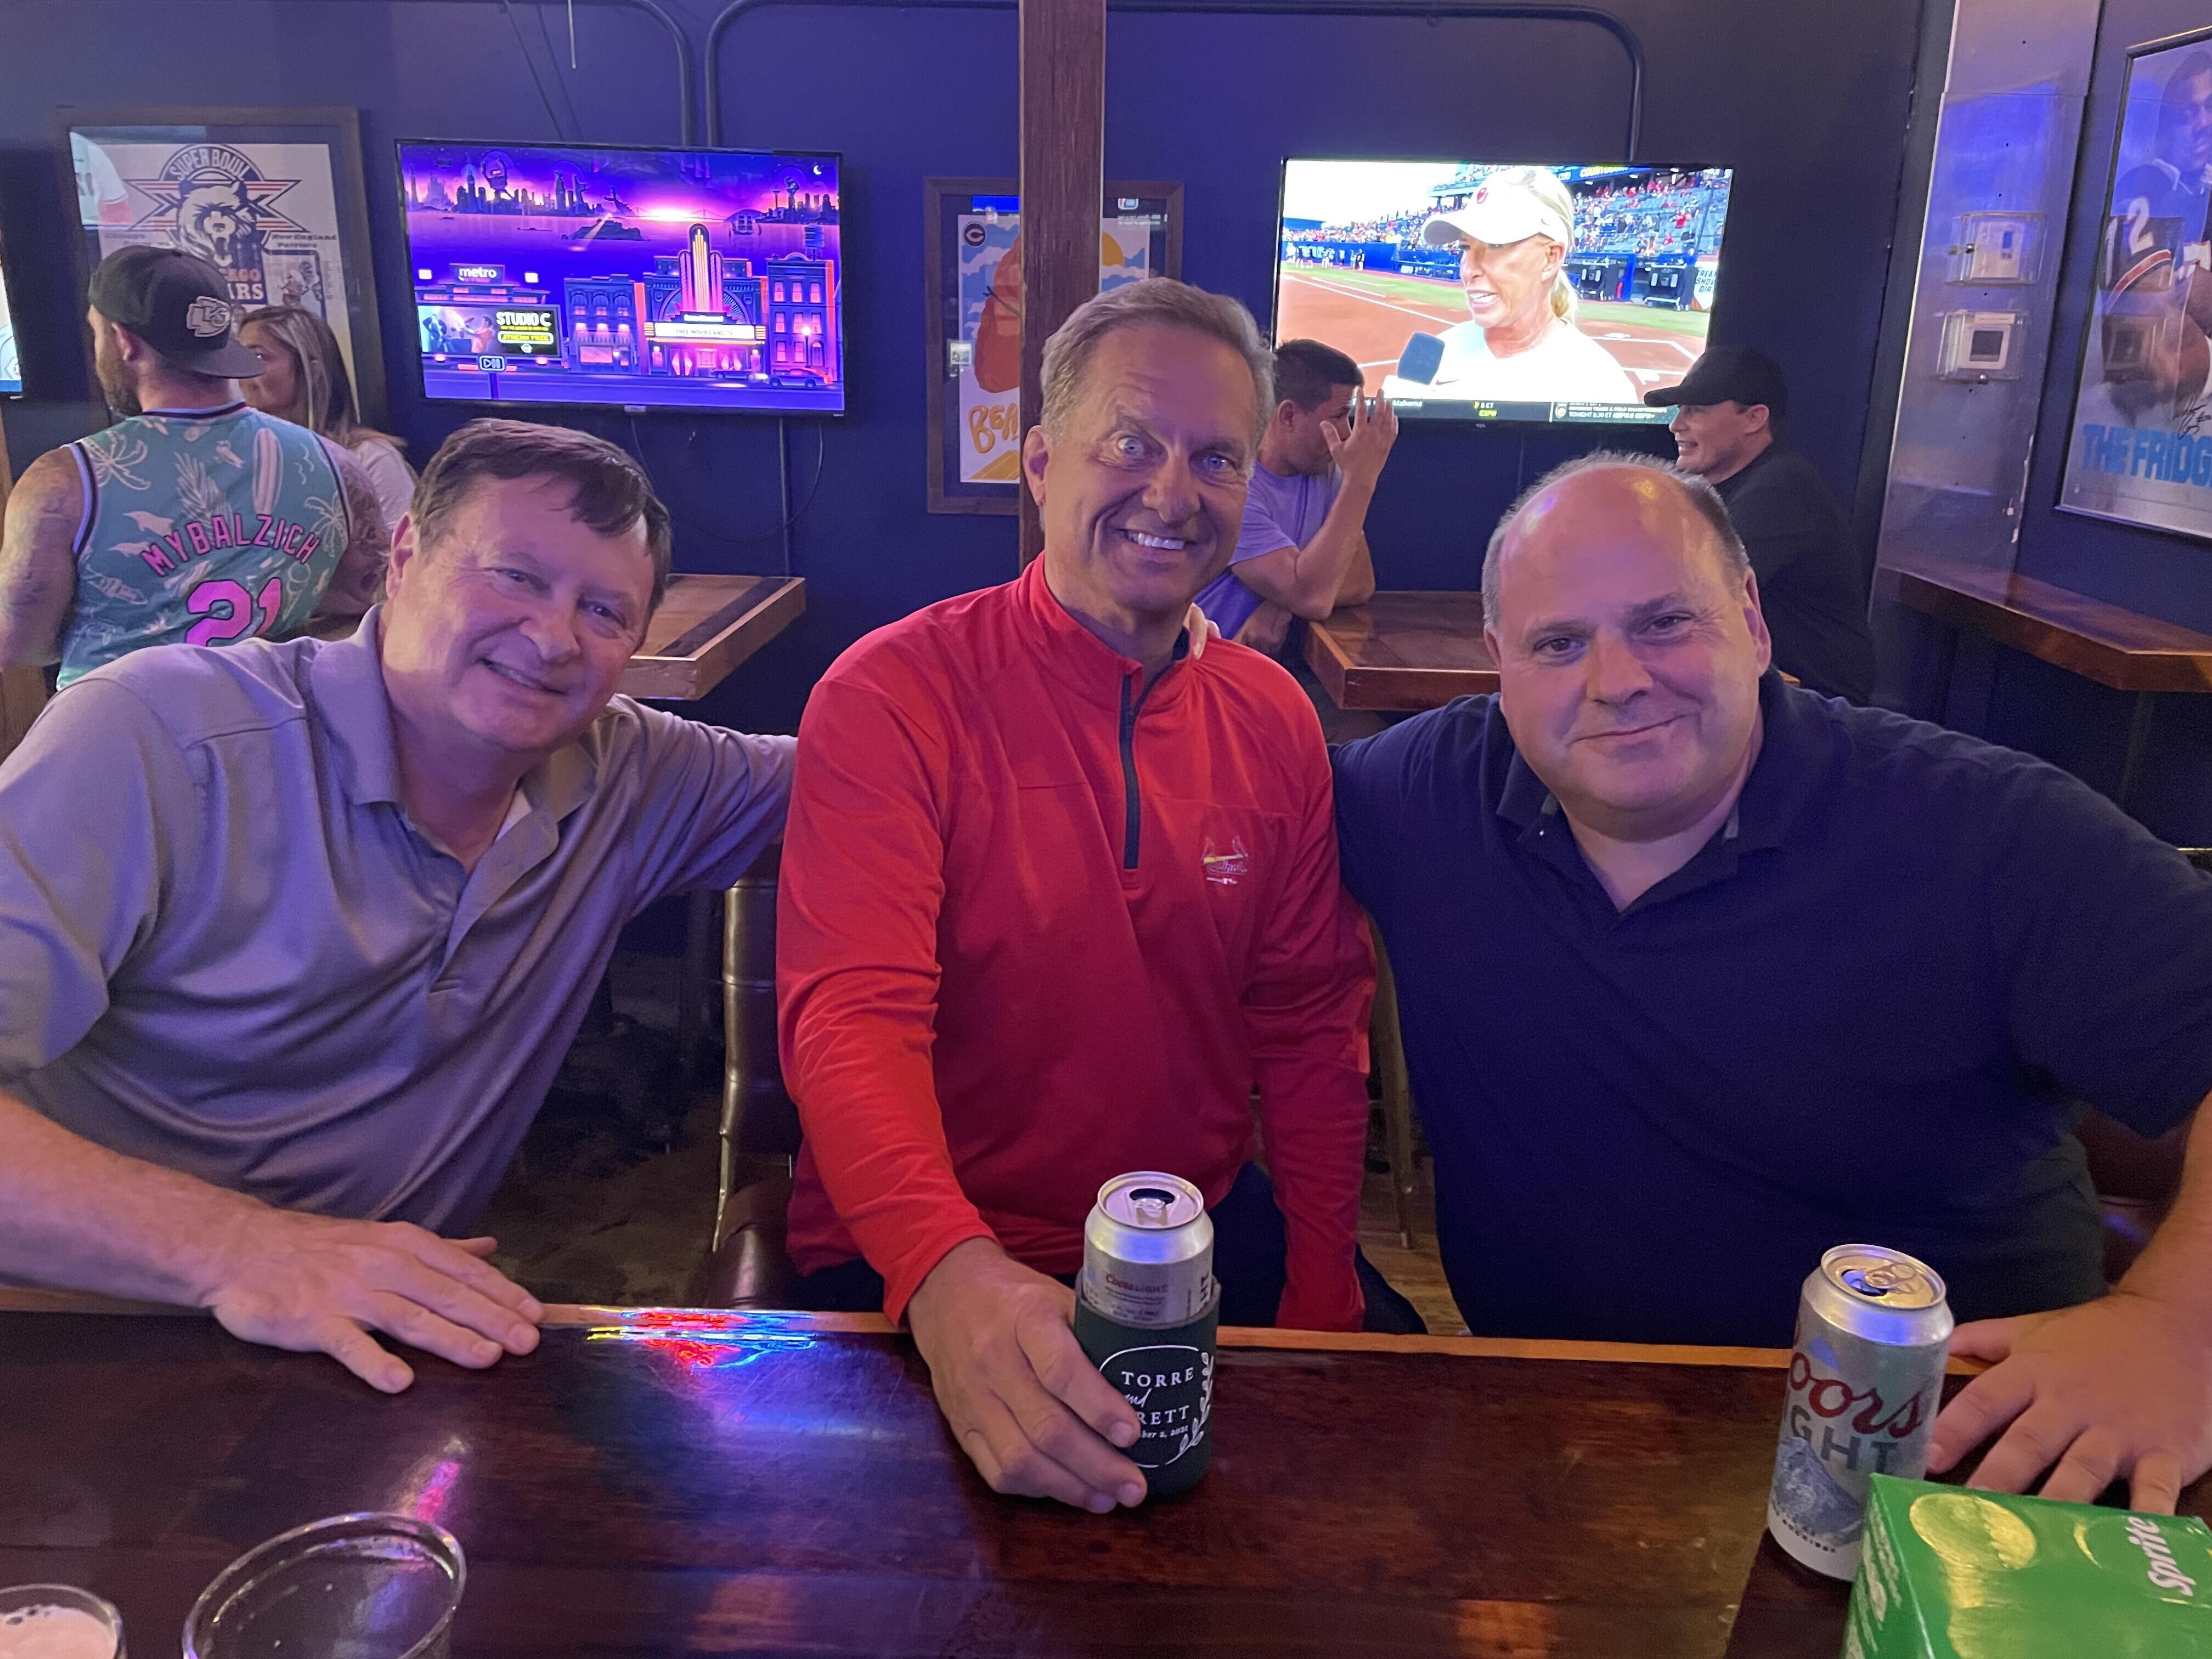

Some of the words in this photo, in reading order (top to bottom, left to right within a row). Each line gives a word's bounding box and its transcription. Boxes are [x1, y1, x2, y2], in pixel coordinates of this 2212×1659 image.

[170, 148, 210, 180] SUPER
[211, 148, 250, 181] BOWL
[459, 267, 497, 278] metro
[496, 311, 539, 326] STUDIO
[540, 313, 551, 327] C
[968, 403, 1018, 454] BEA
[2083, 423, 2131, 475] THE
[141, 514, 320, 576] MYBALZICH
[186, 578, 282, 647] 21
[1121, 1367, 1194, 1387] TORRE
[1789, 1351, 1925, 1439] oors
[1136, 1405, 1189, 1425] RETT
[1790, 1404, 1899, 1473] GHT
[2124, 1516, 2197, 1596] Sprite
